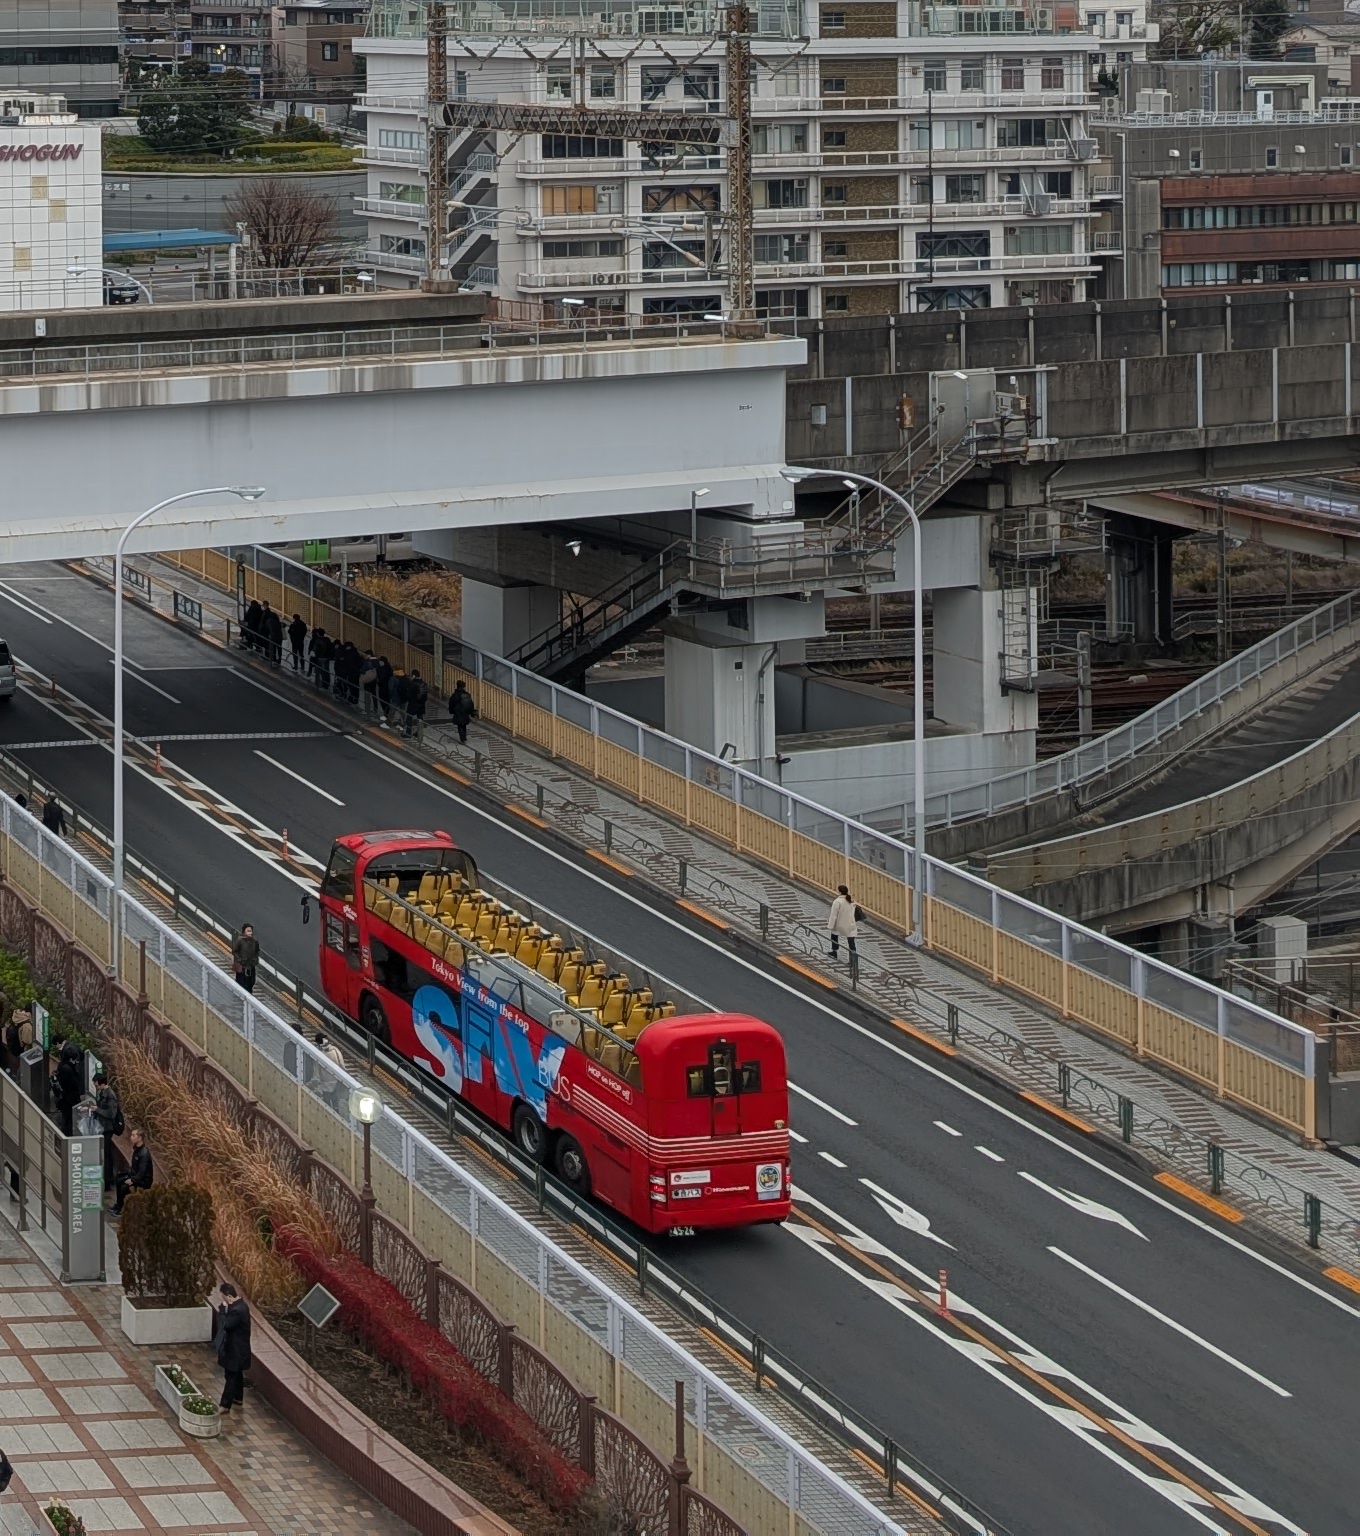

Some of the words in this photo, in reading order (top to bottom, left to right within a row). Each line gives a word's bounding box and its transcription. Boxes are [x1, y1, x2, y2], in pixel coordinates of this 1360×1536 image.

[431, 957, 454, 981] Tokyo
[456, 973, 476, 995] View
[478, 988, 497, 1010] from
[500, 1003, 513, 1020] the
[515, 1014, 530, 1034] top
[538, 1061, 571, 1102] BUS
[588, 1065, 601, 1078] HOP
[609, 1079, 622, 1092] HOP
[72, 1156, 82, 1204] SMOKING
[72, 1207, 82, 1234] AREA
